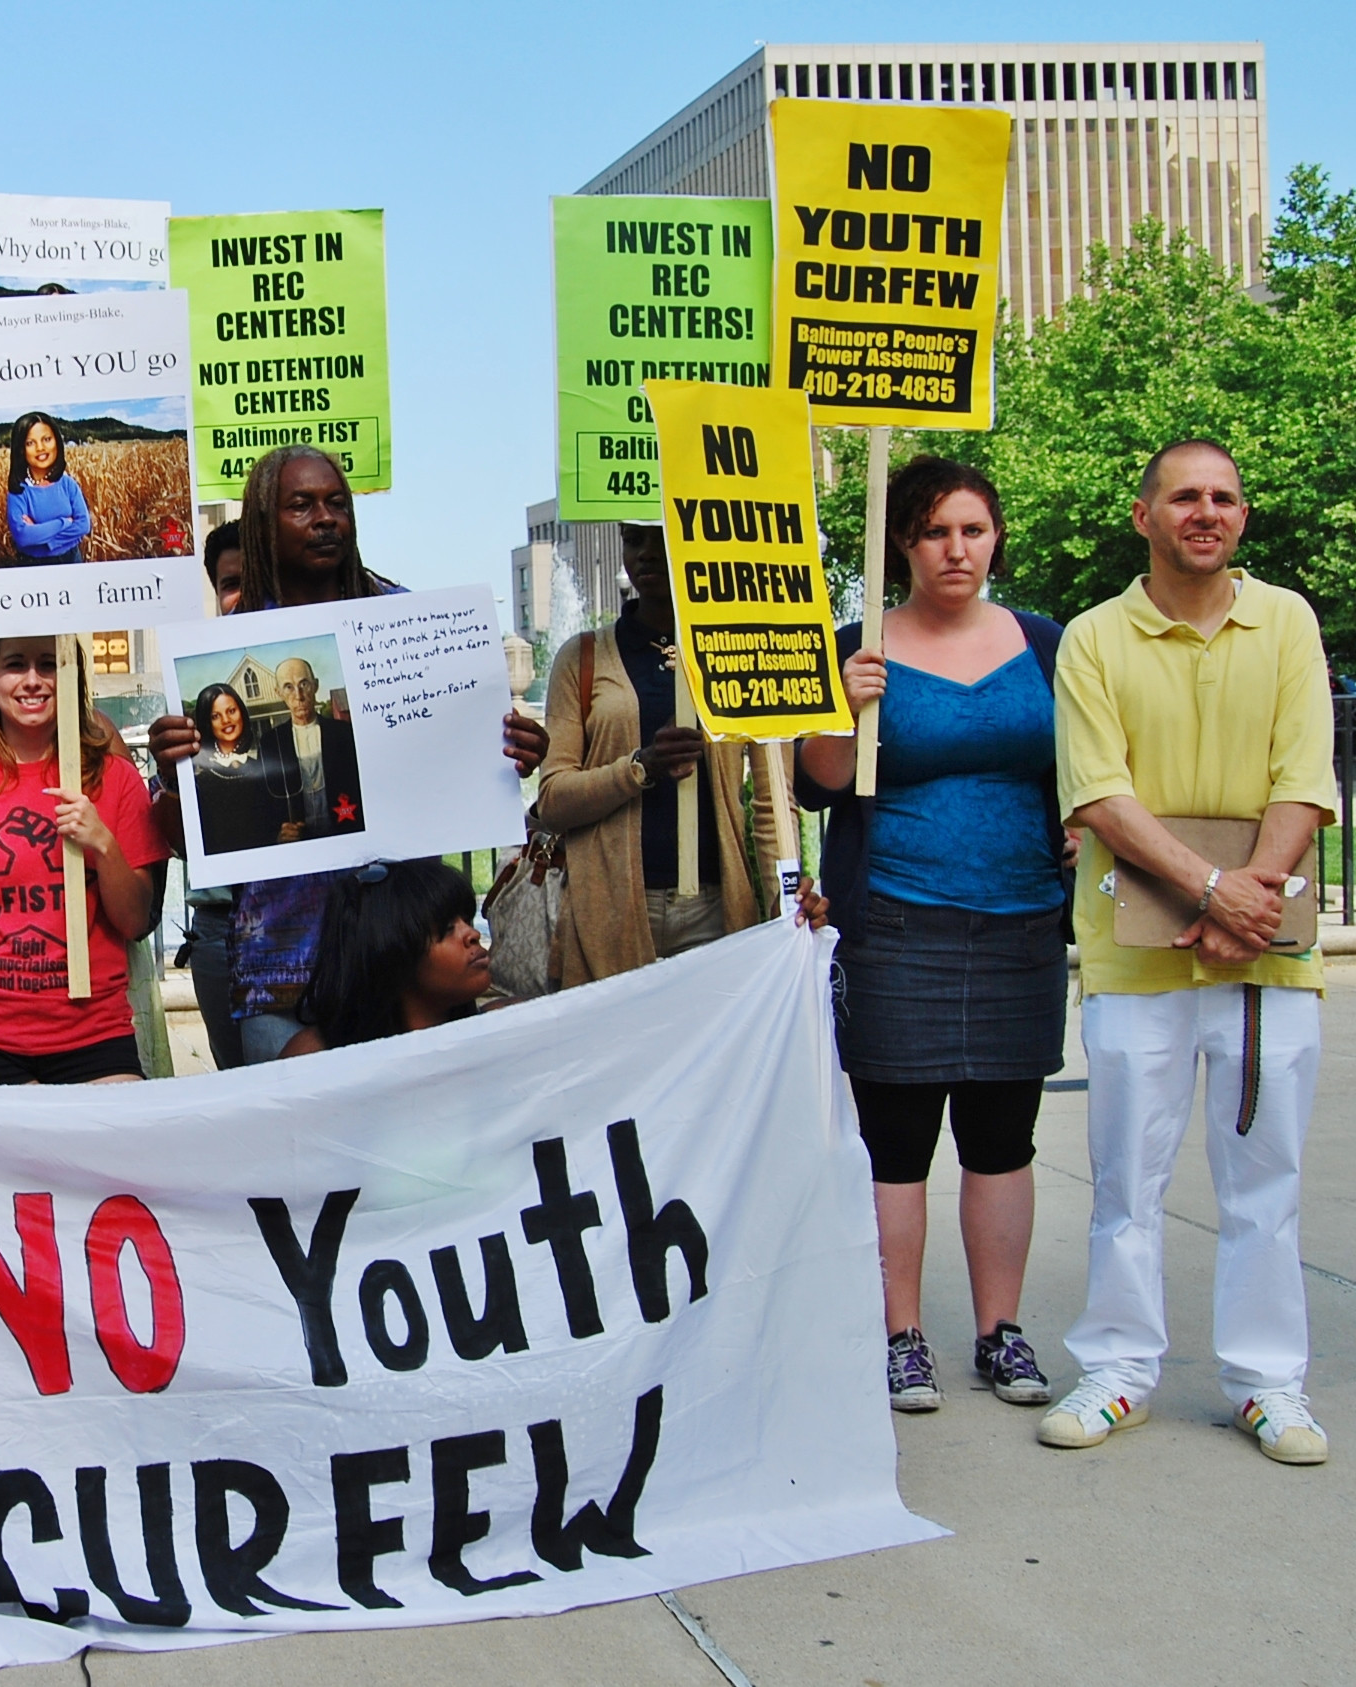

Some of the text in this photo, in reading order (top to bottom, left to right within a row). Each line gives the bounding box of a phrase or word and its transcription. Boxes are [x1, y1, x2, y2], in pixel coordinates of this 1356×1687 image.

[848, 142, 930, 192] NO
[30, 217, 130, 230] Mayor Rawlings-Blake,
[794, 205, 981, 258] YOUTH
[35, 239, 86, 260] don't
[94, 240, 142, 260] YOU
[211, 232, 343, 267] INVEST IN
[606, 221, 751, 258] INVEST IN
[253, 271, 304, 302] REC
[652, 264, 710, 297] REC
[795, 261, 979, 310] CURFEW
[34, 308, 123, 324] Rawlings-Blake,
[217, 306, 345, 341] CENTERS!
[609, 304, 753, 340] CENTERS!
[798, 324, 968, 354] Baltimore People's
[0, 355, 62, 381] don't
[71, 350, 137, 376] YOU
[148, 352, 176, 376] go
[199, 355, 364, 386] NOT DETENTION
[586, 360, 770, 387] NOT DETENTION
[807, 344, 955, 373] Power Assembly
[235, 388, 330, 415] CENTERS
[803, 369, 955, 404] 410-218-4835
[212, 421, 359, 449] Baltimore FIST
[600, 436, 658, 460] Balti
[702, 424, 758, 478] NO
[673, 498, 803, 544] YOUTH
[21, 592, 49, 609] on
[58, 589, 71, 605] a
[96, 577, 162, 604] farm!
[684, 561, 813, 603] CURFEW
[368, 624, 385, 639] you
[389, 618, 414, 628] want
[431, 612, 449, 621] have
[453, 609, 475, 624] your
[380, 639, 397, 648] run
[433, 629, 446, 640] 24
[450, 625, 480, 636] hours
[386, 658, 397, 669] go
[403, 652, 420, 661] live
[424, 646, 440, 657] out
[466, 639, 489, 649] farm
[696, 630, 821, 653] Baltimore People's
[706, 651, 817, 673] Power Assembly
[711, 677, 822, 709] 410-218-4835
[362, 702, 395, 717] Mayor
[386, 707, 432, 728] $nake
[1, 883, 66, 913] FIST
[12, 937, 47, 959] fight
[17, 973, 68, 993] togethe
[247, 1118, 708, 1387] Youth
